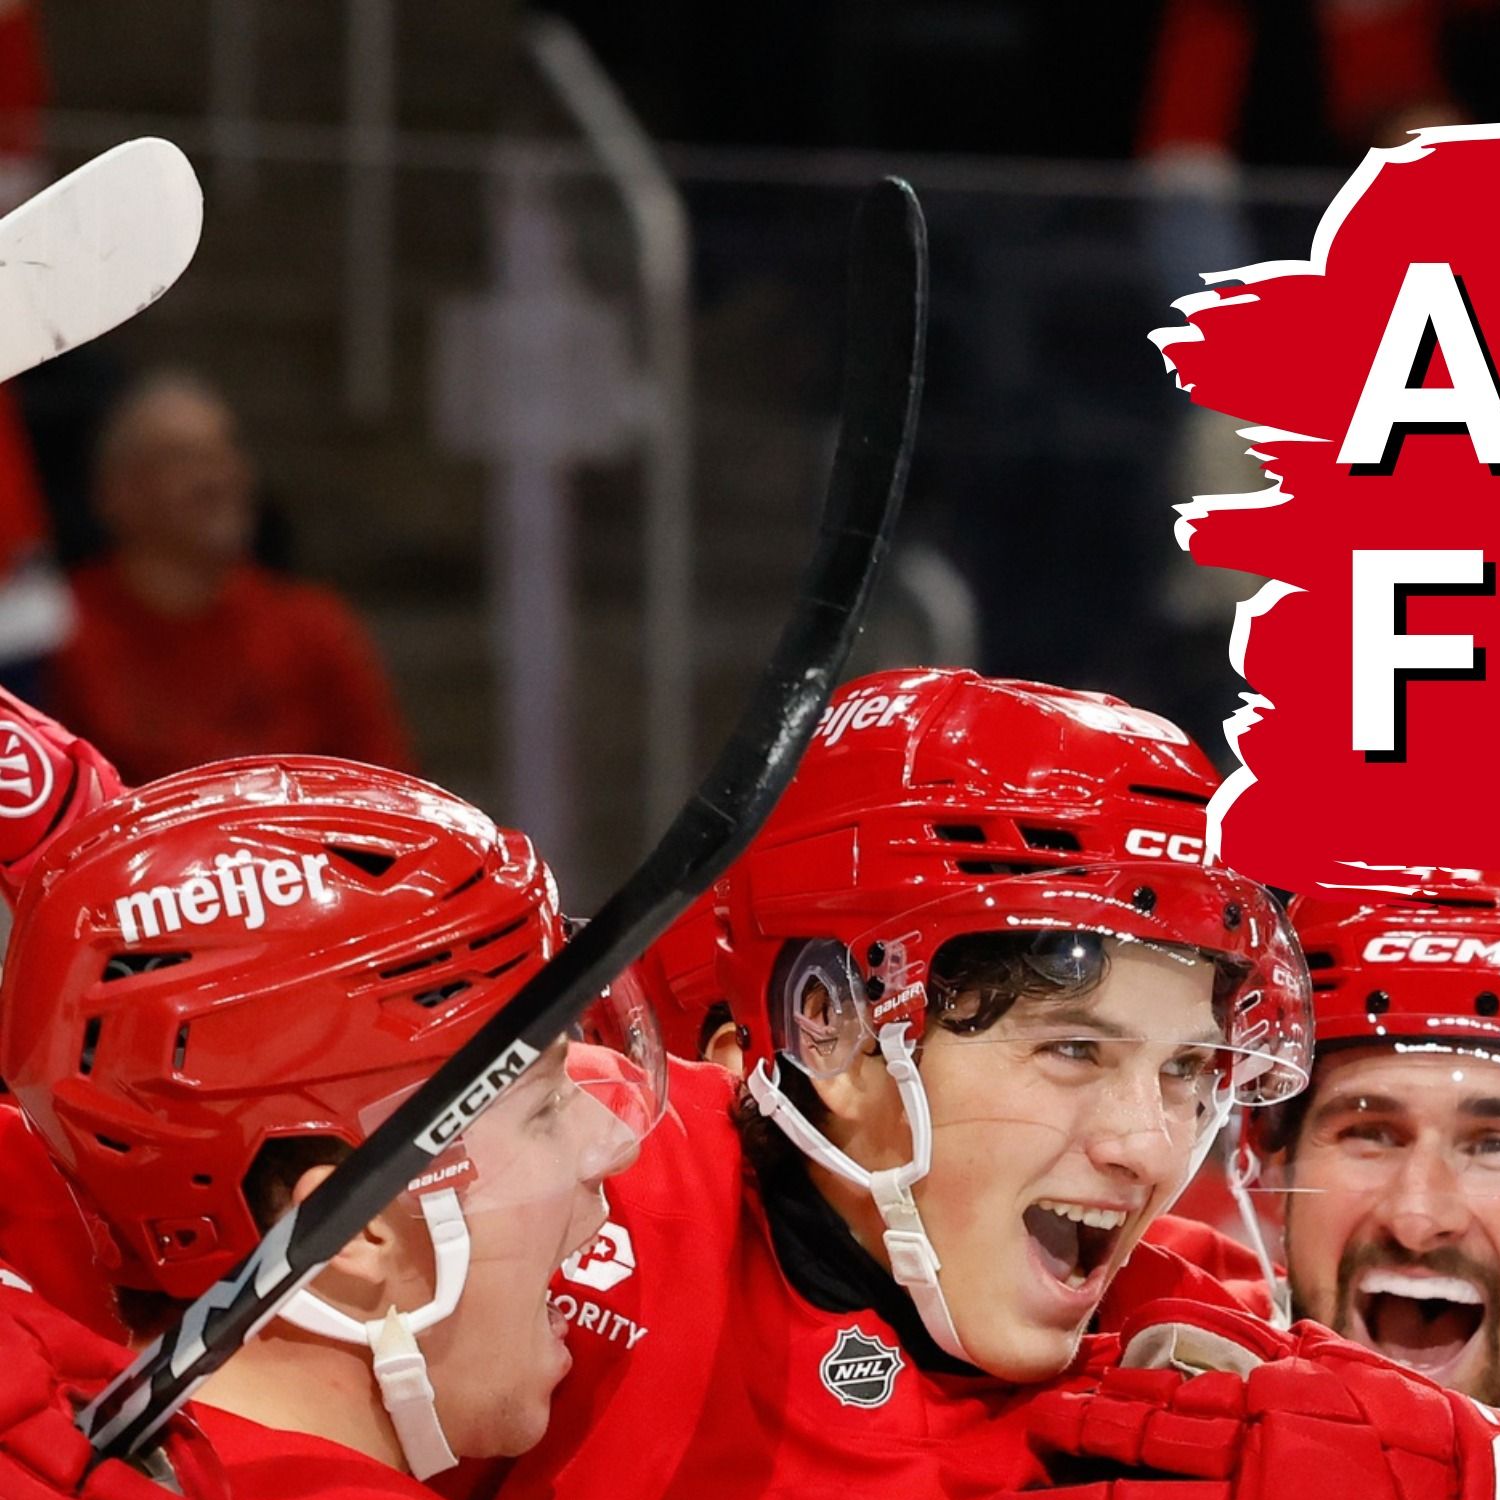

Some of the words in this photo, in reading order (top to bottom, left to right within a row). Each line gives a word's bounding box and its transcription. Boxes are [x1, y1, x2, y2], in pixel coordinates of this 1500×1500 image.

[115, 849, 330, 943] meijer
[430, 1050, 525, 1144] CCM
[834, 1359, 885, 1381] NHL
